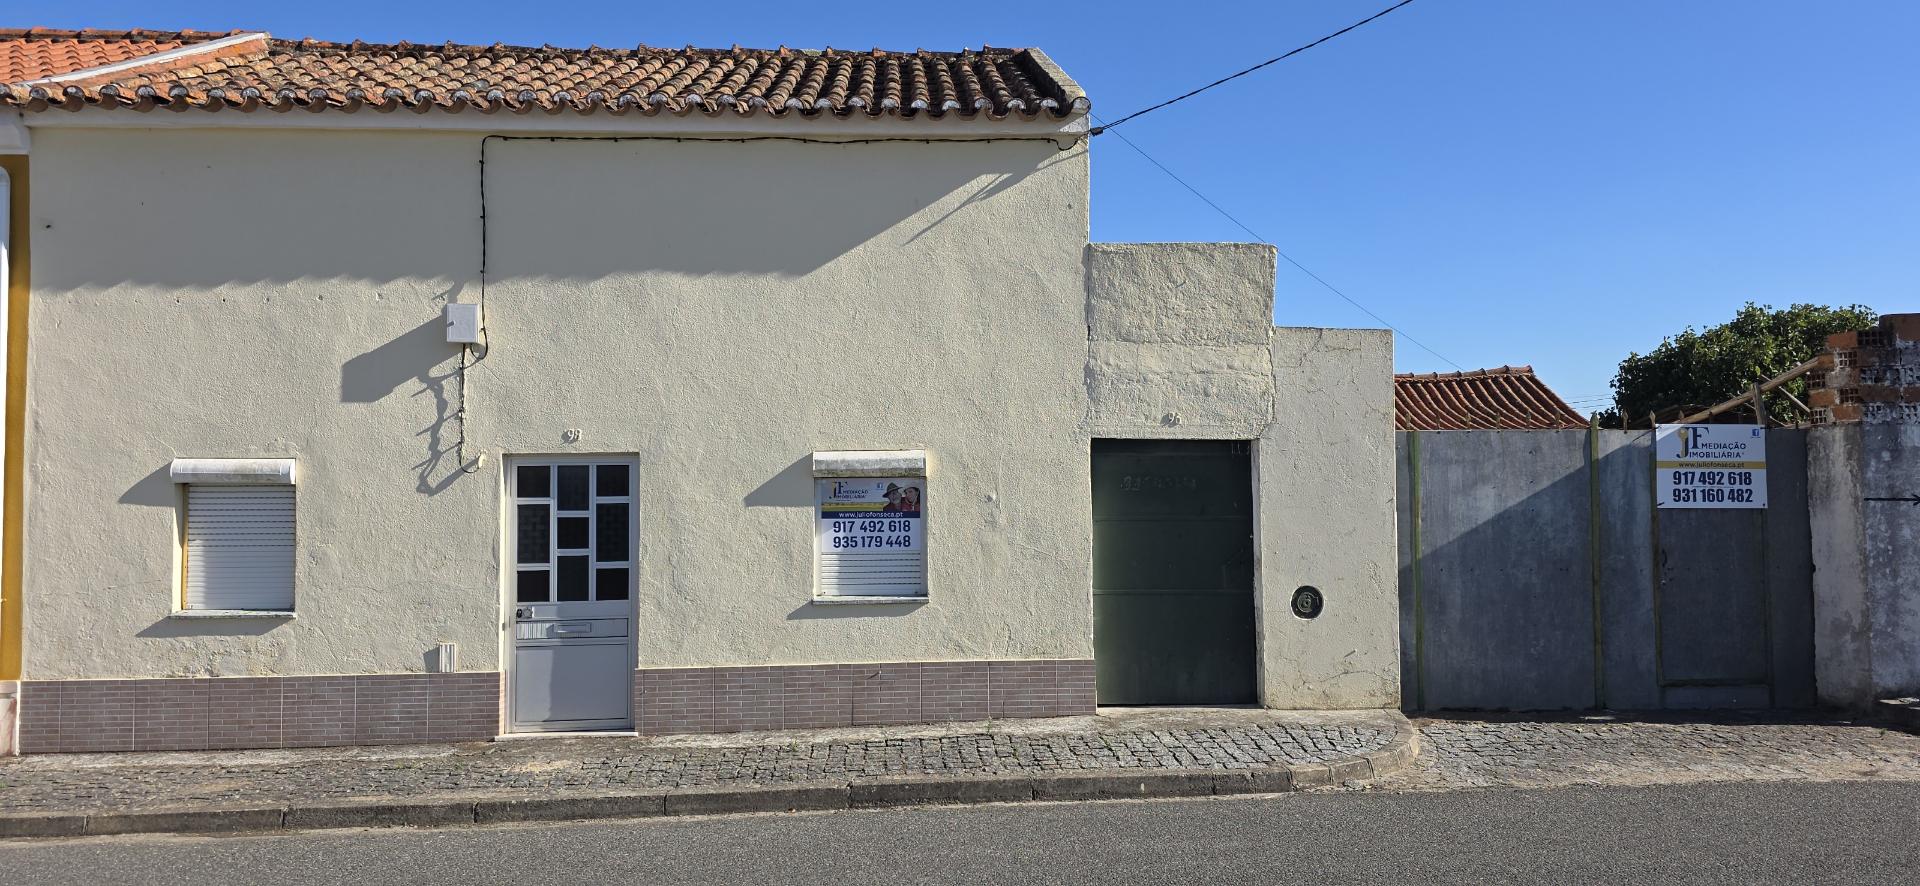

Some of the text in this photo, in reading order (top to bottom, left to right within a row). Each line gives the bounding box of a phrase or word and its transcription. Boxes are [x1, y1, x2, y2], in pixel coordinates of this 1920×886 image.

[1701, 441, 1746, 450] MEDIAÇÃO
[1673, 470, 1753, 486] 917 492 618
[1672, 488, 1753, 503] 931 160 482
[833, 520, 911, 533] 917 492 618
[833, 535, 911, 548] 935 179 448
